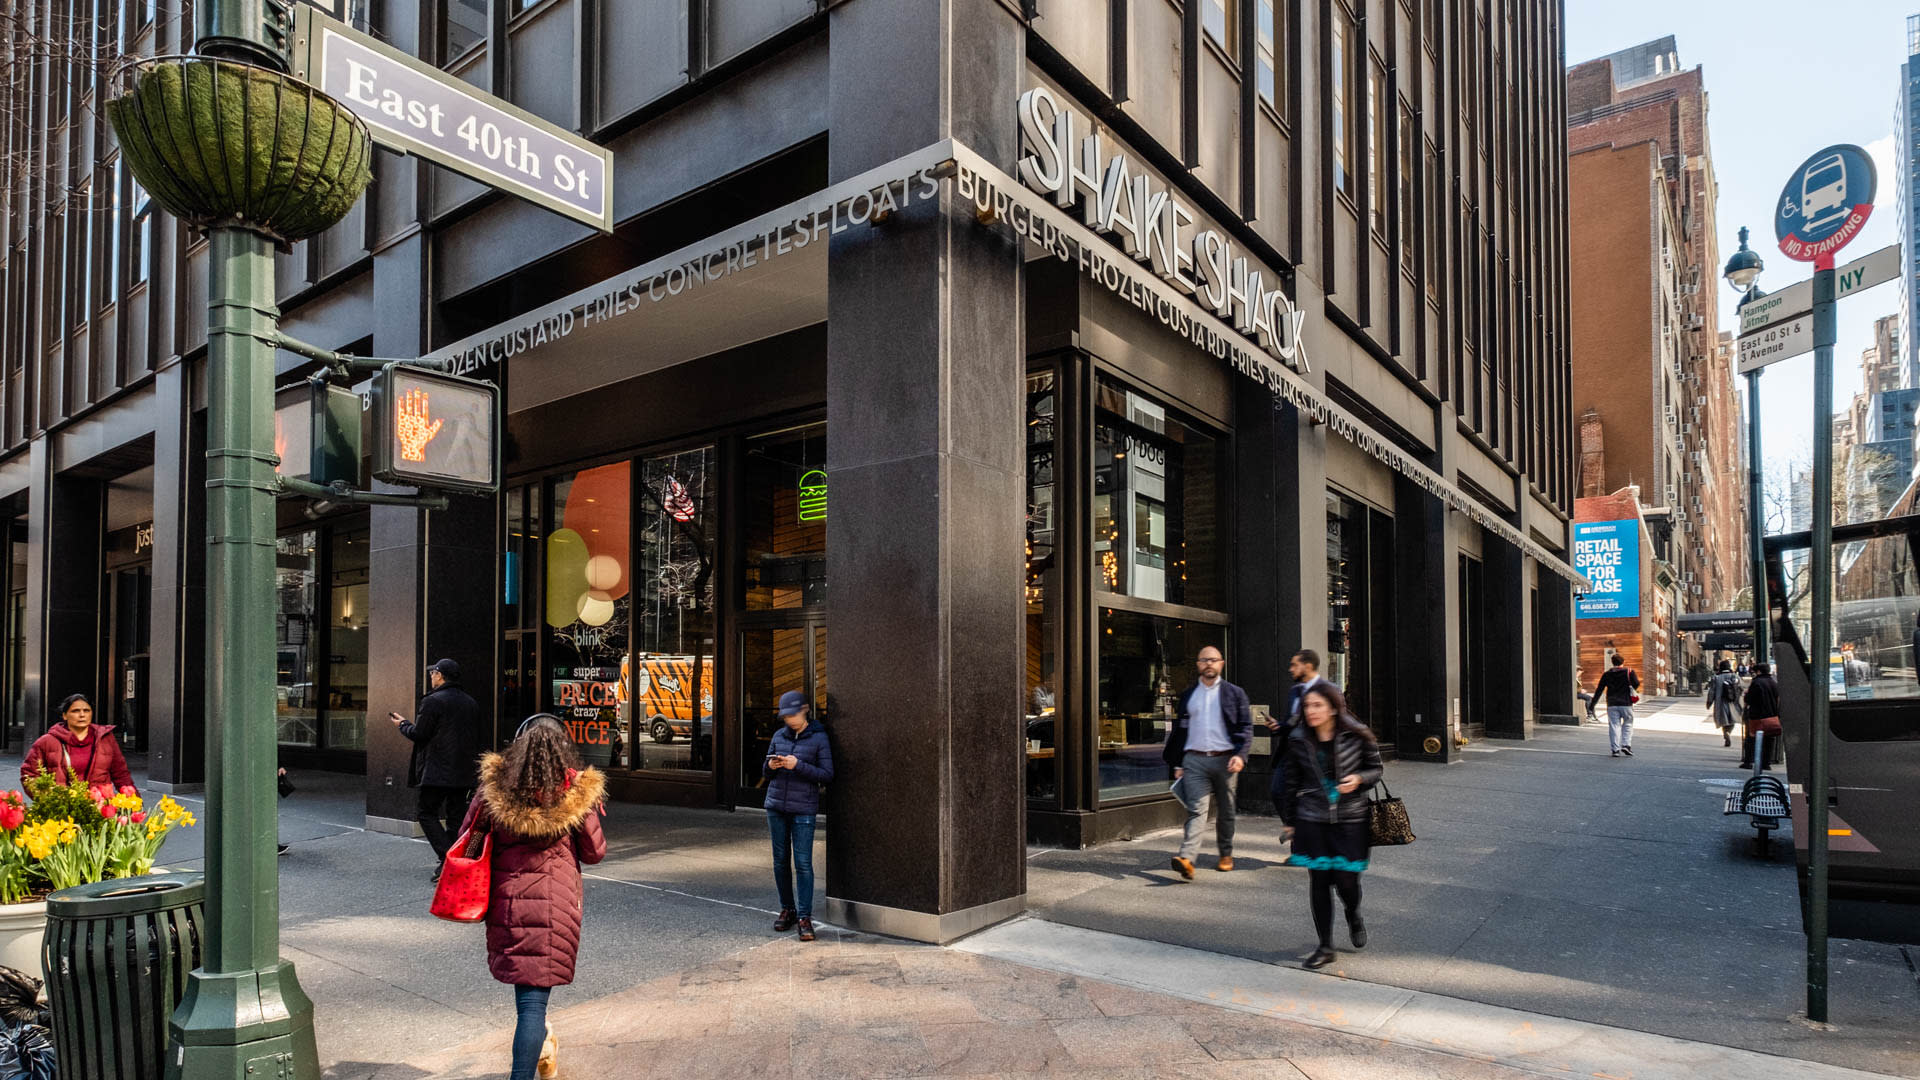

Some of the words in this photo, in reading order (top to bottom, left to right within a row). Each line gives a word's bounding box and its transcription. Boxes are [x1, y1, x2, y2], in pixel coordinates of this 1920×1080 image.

[344, 58, 445, 138] East
[457, 115, 542, 180] 40th
[553, 154, 590, 200] St
[1017, 87, 1195, 294] SHAKE
[1193, 229, 1311, 374] SHACK
[1784, 240, 1802, 255] NO
[1804, 213, 1863, 257] STANDING
[1839, 266, 1865, 293] NY
[1743, 297, 1783, 318] Hampton
[442, 344, 487, 376] OZEN
[490, 310, 575, 362] CUSTARD
[583, 282, 640, 327] FRIES
[957, 165, 1069, 262] BURGERS
[1078, 241, 1155, 317] FROZEN
[1157, 296, 1226, 359] CUSTARD
[1231, 342, 1265, 384] FRIES
[1268, 369, 1307, 412] SHAKES
[1310, 396, 1328, 427] HOT
[1331, 408, 1353, 443] DOGS
[1357, 431, 1401, 472] CONCRETES
[1744, 313, 1770, 329] Jitney
[1741, 337, 1761, 352] East
[1764, 333, 1776, 343] 40
[1780, 328, 1790, 338] St
[1794, 323, 1801, 333] &
[1741, 353, 1747, 363] 3
[1750, 342, 1784, 359] Avenue
[1575, 538, 1623, 554] RETAIL
[1576, 552, 1622, 567] SPACE
[1587, 566, 1615, 580] FOR
[1577, 579, 1622, 594] ASE
[575, 629, 601, 646] blink
[573, 667, 601, 680] super
[559, 681, 615, 706] PRICE
[574, 707, 600, 720] crazy
[565, 721, 610, 745] NICE
